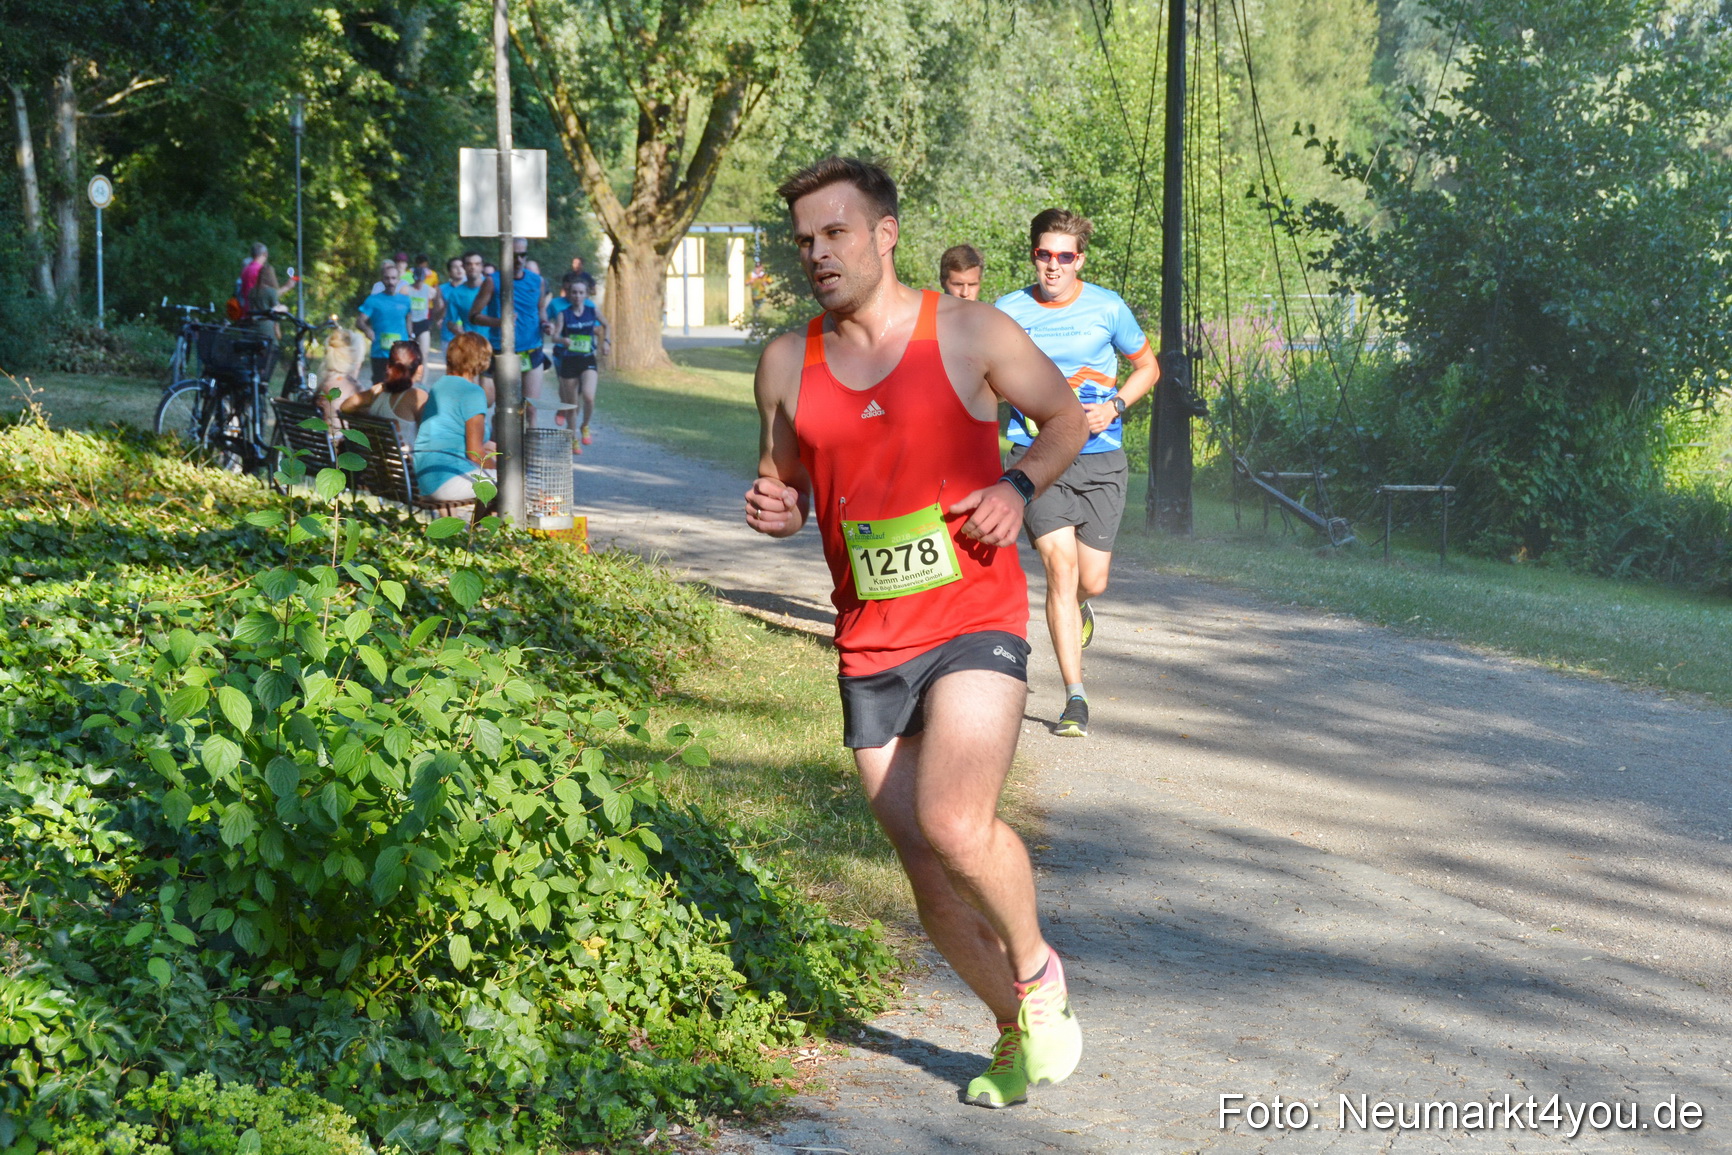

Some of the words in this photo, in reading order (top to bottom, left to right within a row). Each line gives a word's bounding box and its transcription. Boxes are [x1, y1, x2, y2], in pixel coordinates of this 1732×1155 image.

[861, 409, 885, 419] adidas
[891, 533, 911, 543] 2018
[859, 538, 939, 577] 1278
[873, 577, 899, 586] Kamm
[900, 568, 934, 582] Jennifer
[893, 579, 925, 590] Bauservice
[925, 573, 943, 582] GmbH
